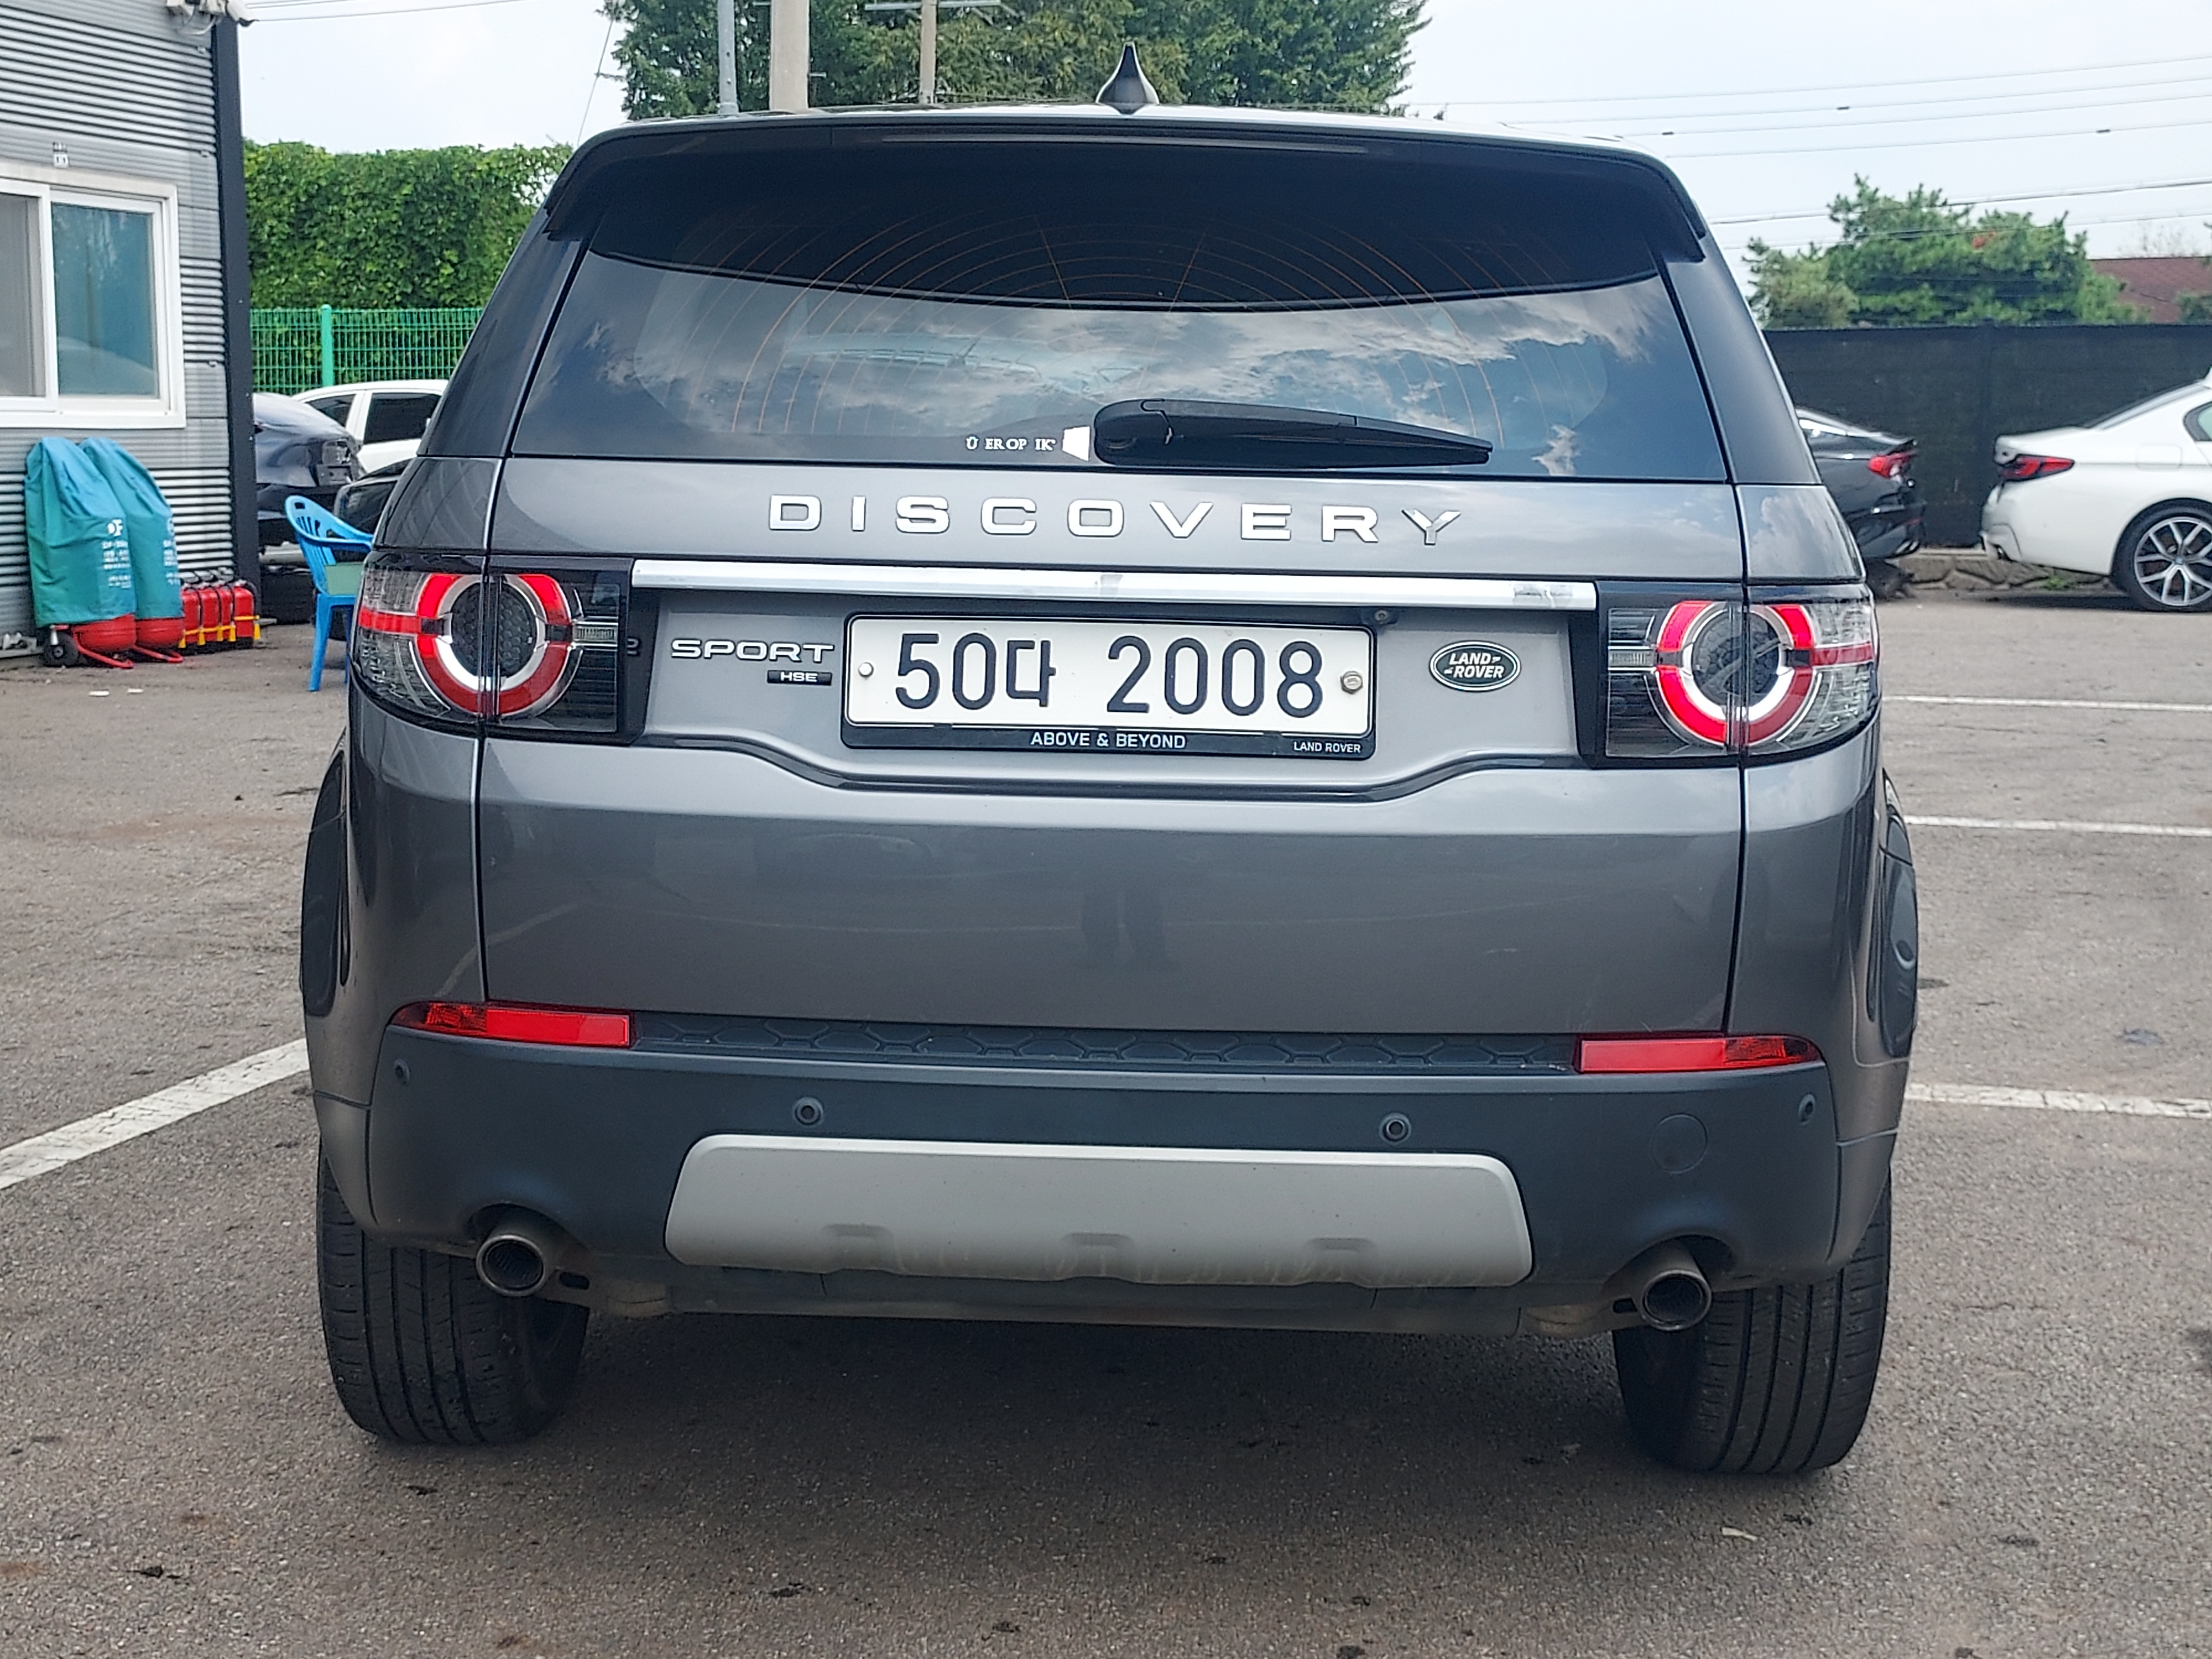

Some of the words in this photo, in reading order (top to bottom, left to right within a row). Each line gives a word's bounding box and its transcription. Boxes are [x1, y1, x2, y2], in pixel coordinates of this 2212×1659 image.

[769, 494, 1461, 546] DISCOVERY
[671, 639, 835, 664] SPORT
[1449, 652, 1491, 665] LAND
[780, 671, 818, 683] HSE
[895, 632, 1057, 711] 50다
[1107, 635, 1323, 718] 2008
[1453, 665, 1505, 679] ROVER
[1030, 732, 1091, 747] ABOVE
[1097, 733, 1109, 747] &
[1116, 733, 1186, 749] BEYOND
[1293, 741, 1322, 752] LAND
[1325, 743, 1361, 754] ROVER
